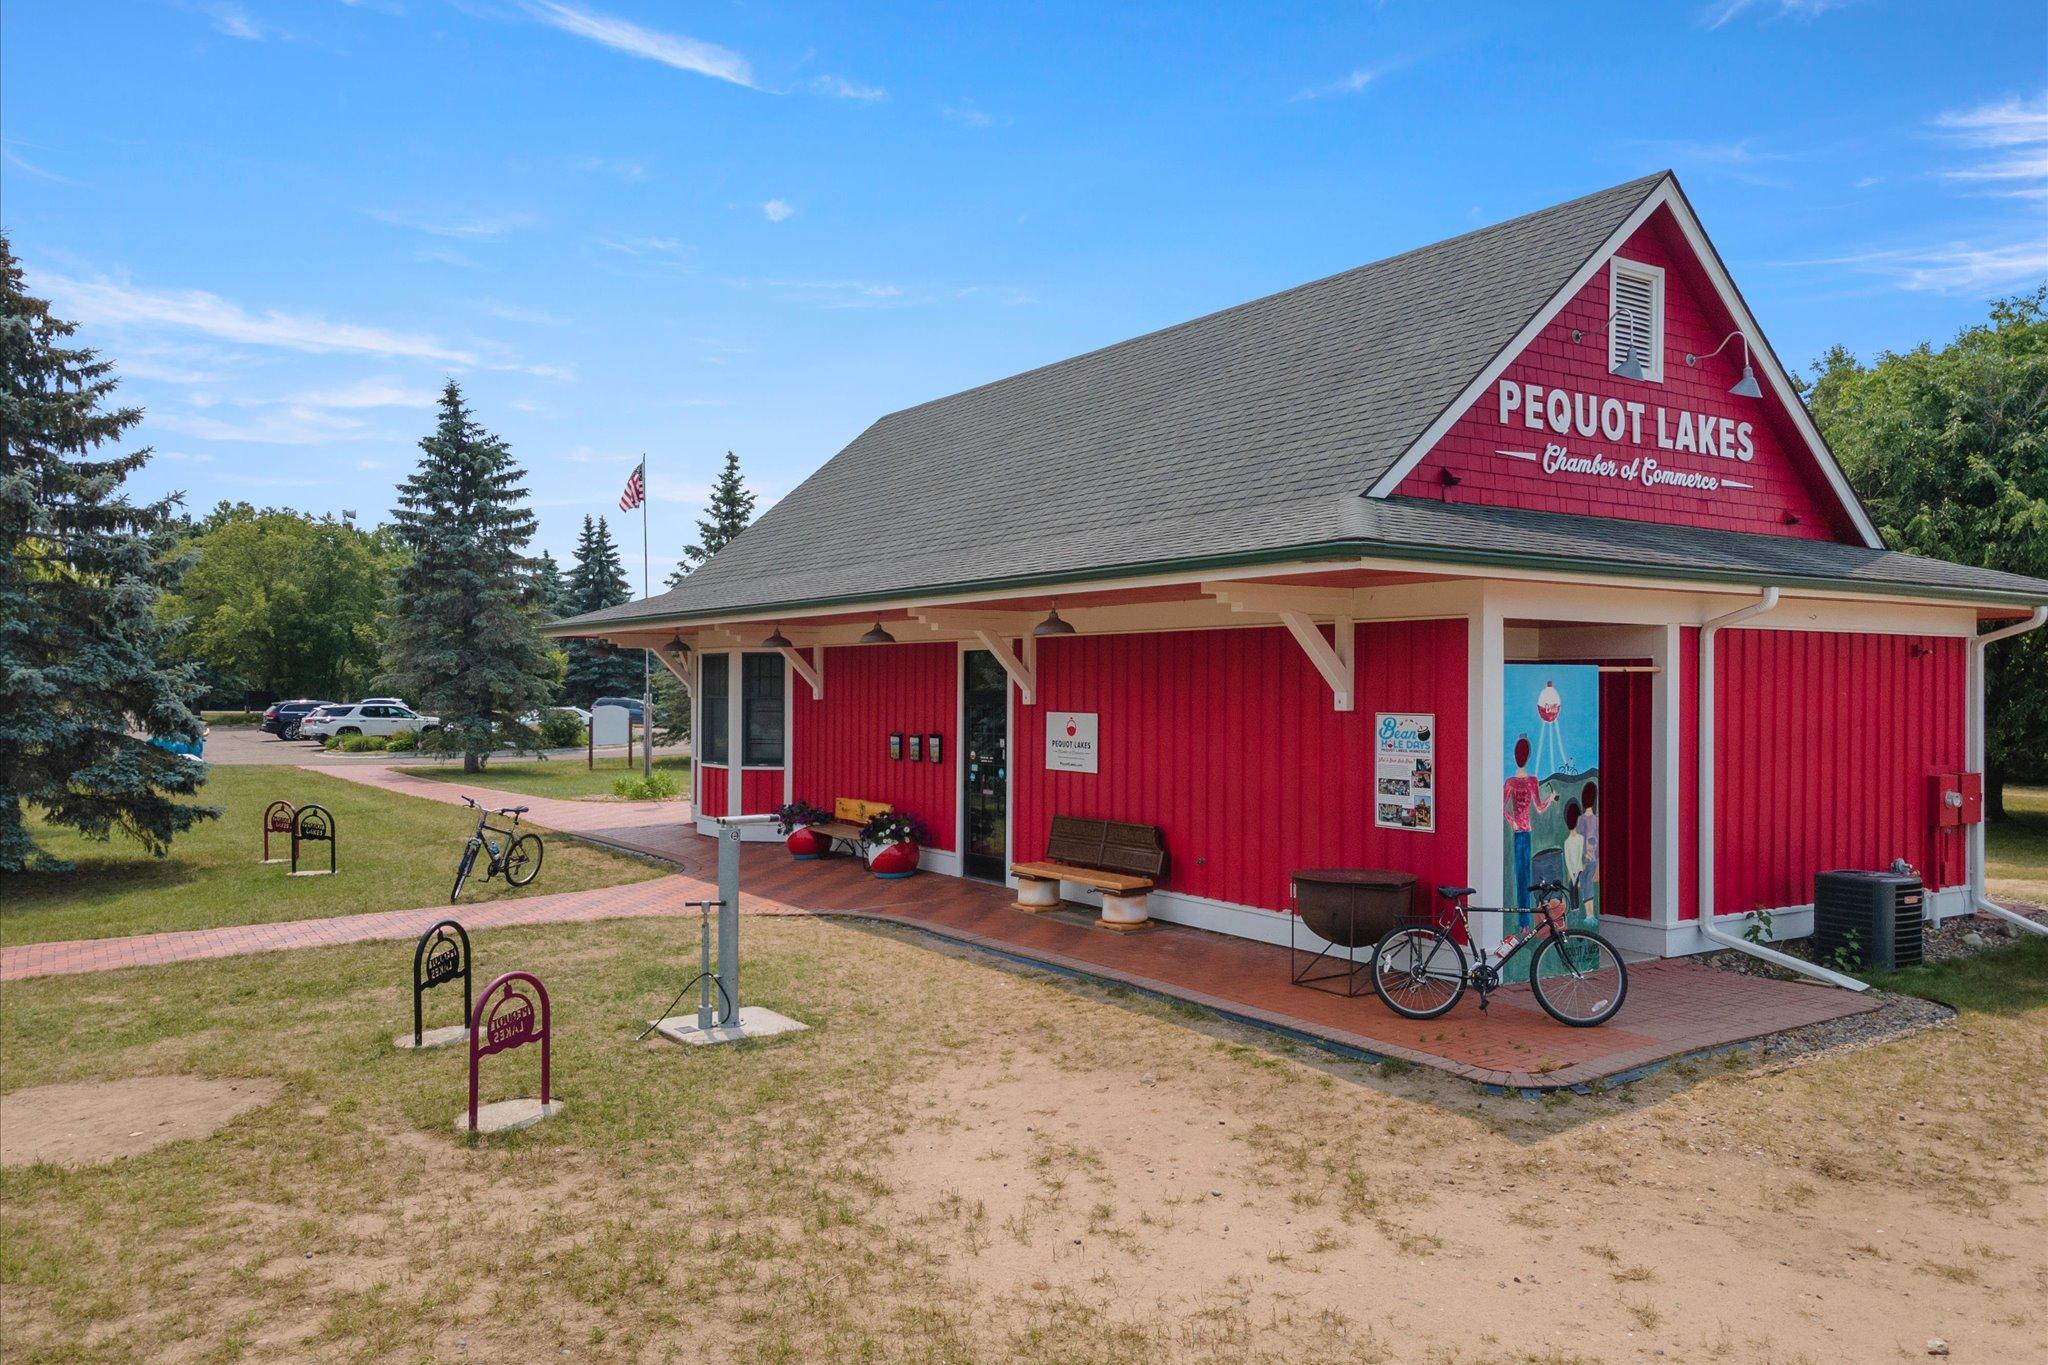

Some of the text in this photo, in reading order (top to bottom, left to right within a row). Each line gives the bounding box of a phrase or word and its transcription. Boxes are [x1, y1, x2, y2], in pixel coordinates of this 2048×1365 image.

[1499, 379, 1754, 462] PEQUOT LAKES
[1542, 443, 1719, 491] Chamber of Commerce
[1379, 716, 1417, 739] Bean
[1051, 739, 1091, 750] PEQUOT LAKES
[1406, 740, 1431, 750] DAYS
